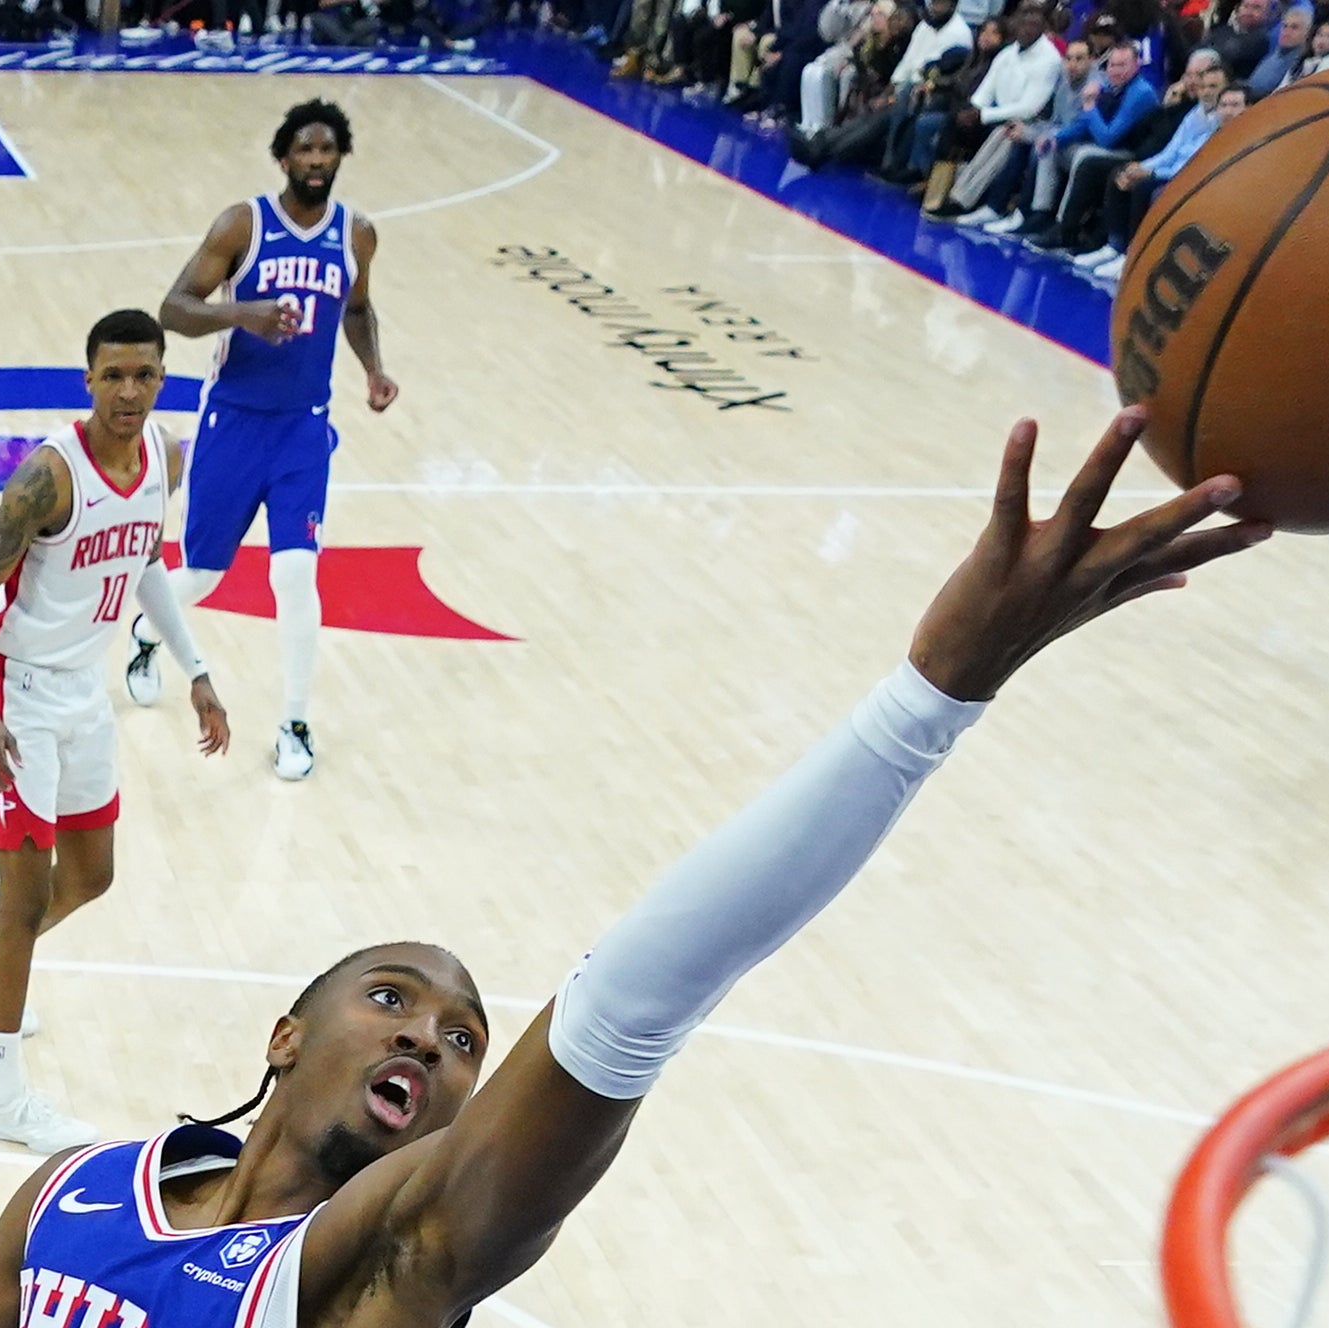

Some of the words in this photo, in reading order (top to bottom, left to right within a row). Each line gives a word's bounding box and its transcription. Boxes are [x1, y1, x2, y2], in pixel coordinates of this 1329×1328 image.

[256, 256, 342, 298] PHILA
[70, 520, 159, 571] ROCKETS
[93, 573, 129, 623] 10
[183, 1262, 247, 1293] crypto.com
